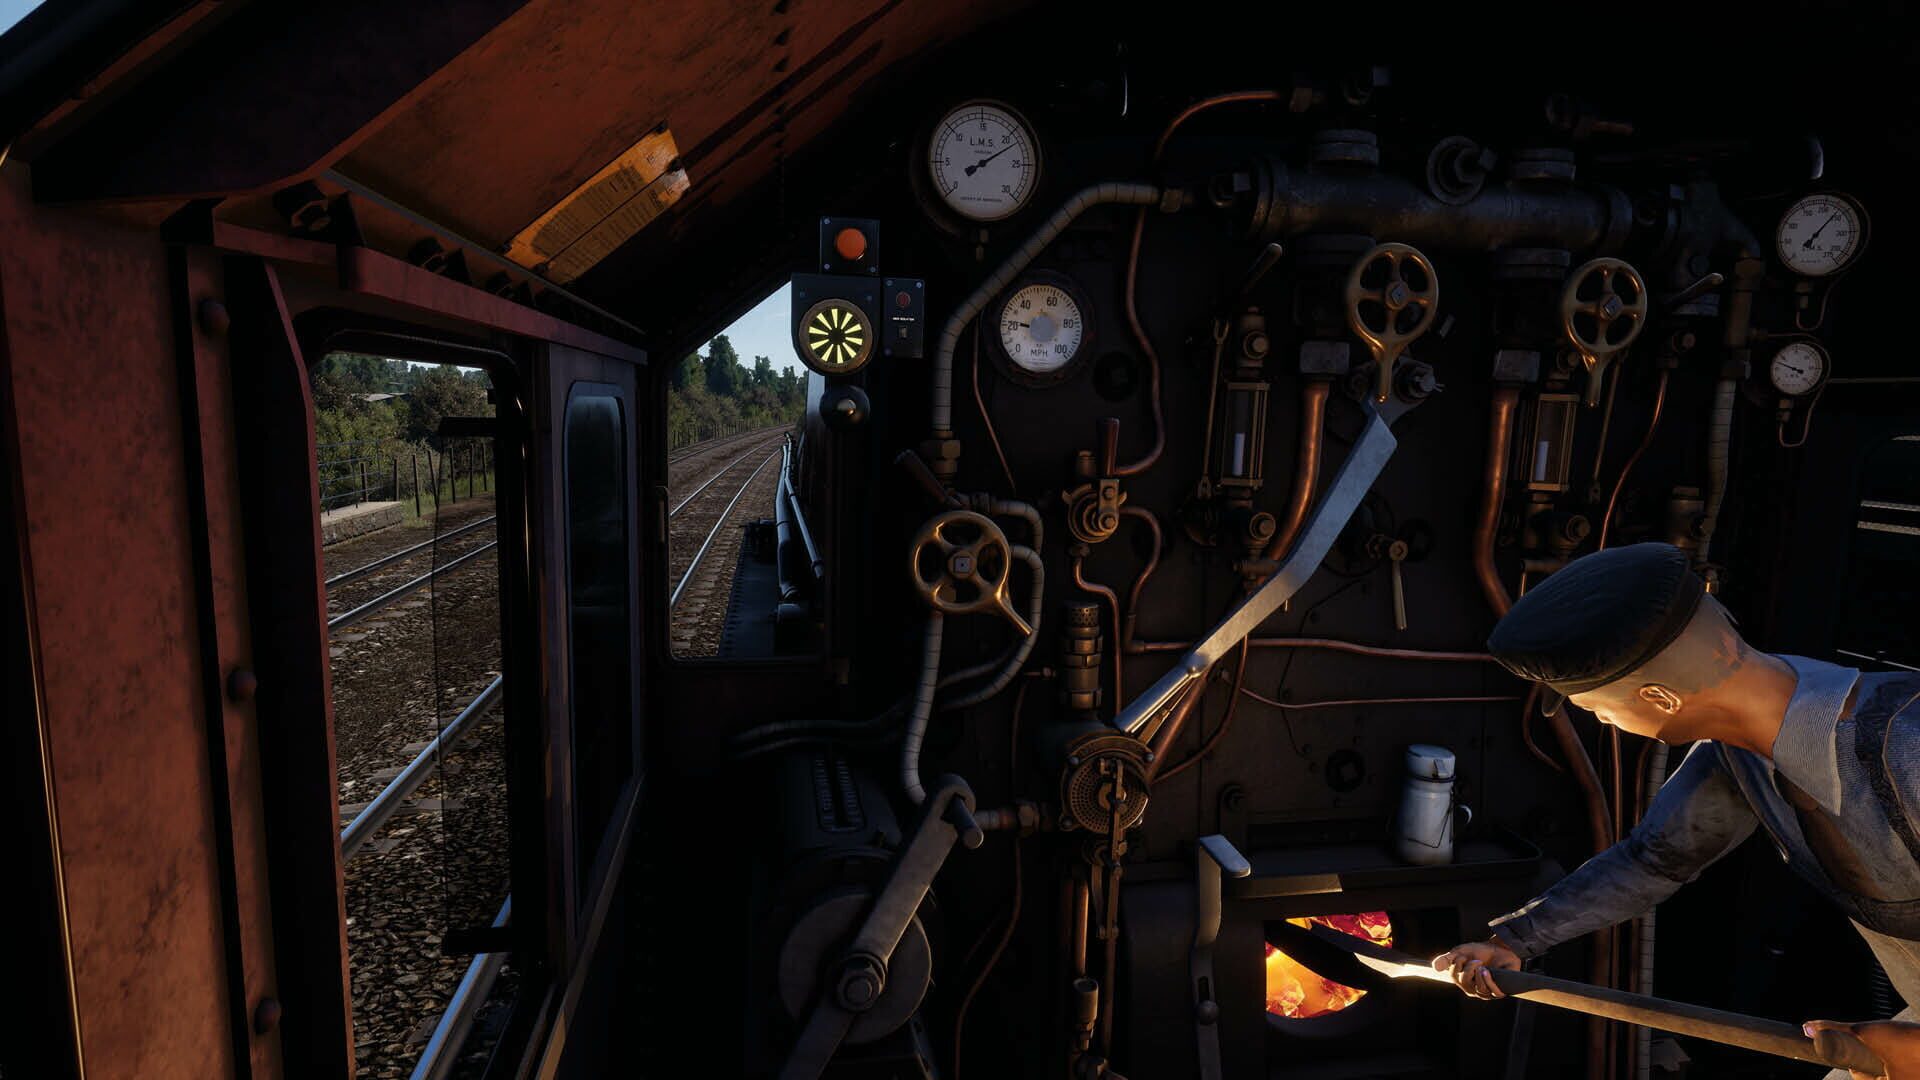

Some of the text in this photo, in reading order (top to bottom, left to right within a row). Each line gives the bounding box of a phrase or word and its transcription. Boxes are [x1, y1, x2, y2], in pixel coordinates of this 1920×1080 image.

[1001, 135, 1010, 145] 20
[945, 157, 950, 166] 5
[1012, 160, 1020, 168] 25
[1001, 185, 1010, 193] 30
[1020, 300, 1031, 310] 40
[1046, 297, 1058, 307] 60
[1007, 321, 1018, 331] 20
[1063, 319, 1074, 328] 80
[1015, 344, 1021, 353] 0
[1030, 349, 1048, 357] MPH
[1054, 344, 1067, 354] 100
